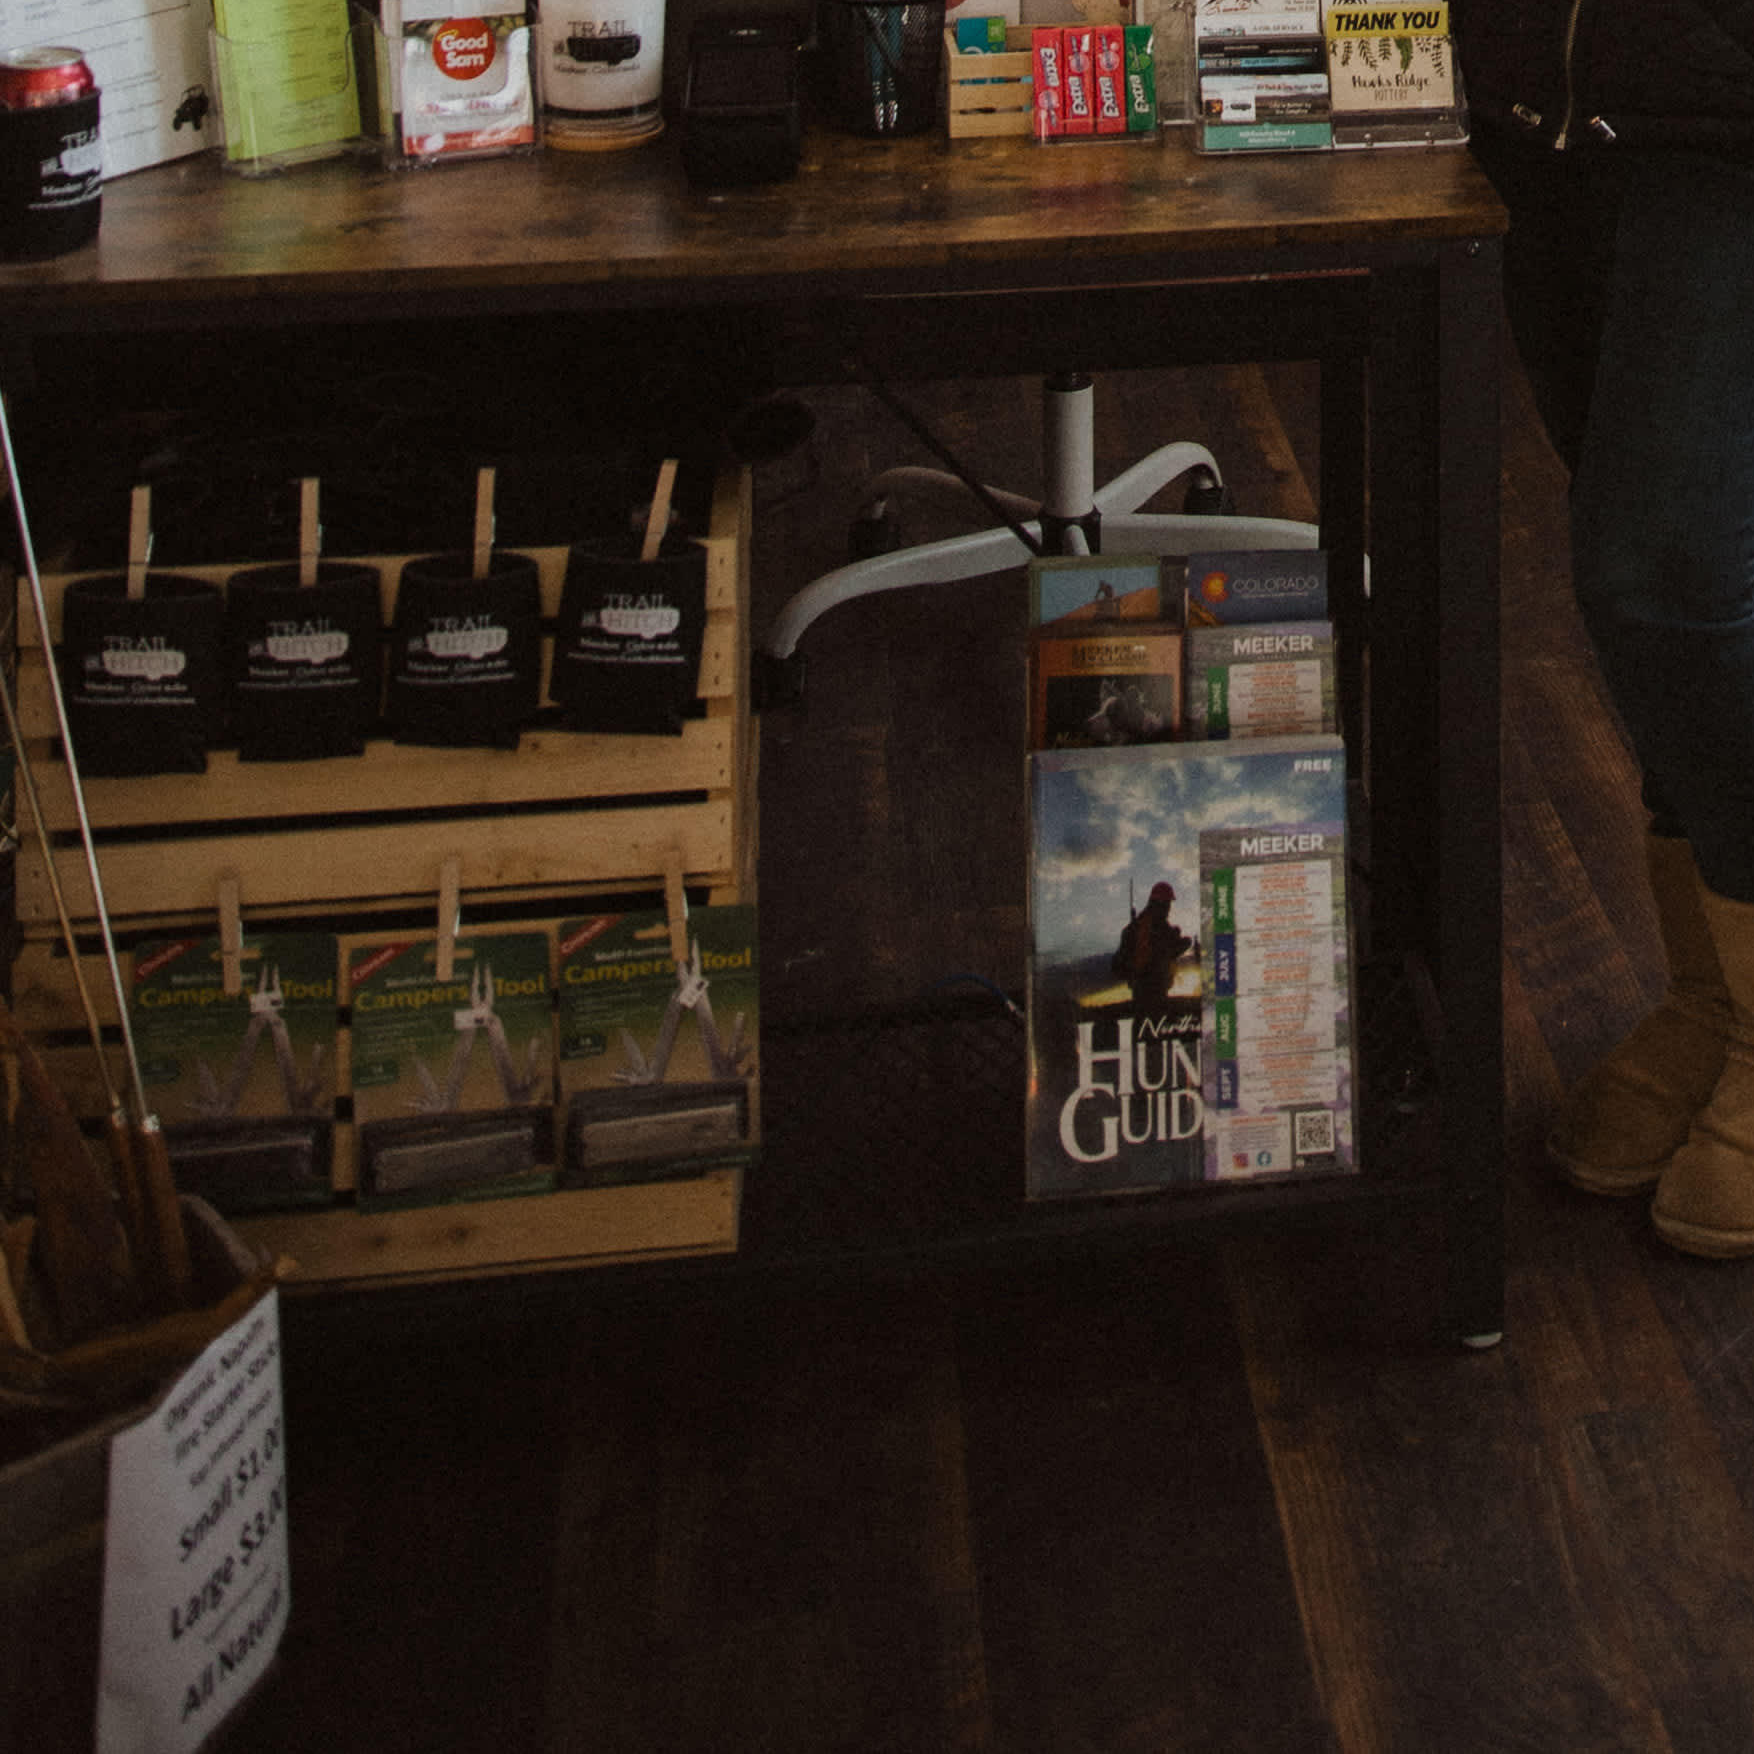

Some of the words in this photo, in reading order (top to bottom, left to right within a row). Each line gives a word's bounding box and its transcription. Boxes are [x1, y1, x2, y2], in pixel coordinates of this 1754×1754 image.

[567, 20, 633, 37] TRAIL
[1335, 12, 1397, 32] THANK
[1401, 10, 1441, 29] YOU
[440, 34, 489, 52] Good
[445, 52, 485, 68] Sam
[1395, 72, 1429, 92] Ridge
[1232, 577, 1319, 592] COLORADO
[603, 593, 667, 610] TRAIL
[104, 636, 174, 652] TRAIL
[1233, 635, 1314, 656] MEEKER
[1294, 758, 1332, 773] FREE
[1240, 833, 1325, 857] MEEKER
[563, 959, 678, 985] Campers
[703, 947, 752, 970] Tool
[1218, 949, 1230, 982] JULY
[281, 978, 334, 998] Tool
[354, 983, 470, 1012] Campers
[494, 974, 546, 997] Tool
[1219, 1013, 1231, 1042] AUG
[1220, 1067, 1233, 1101] SEPT
[178, 1475, 233, 1564] Small
[168, 1554, 236, 1642] Large
[181, 1658, 214, 1724] All
